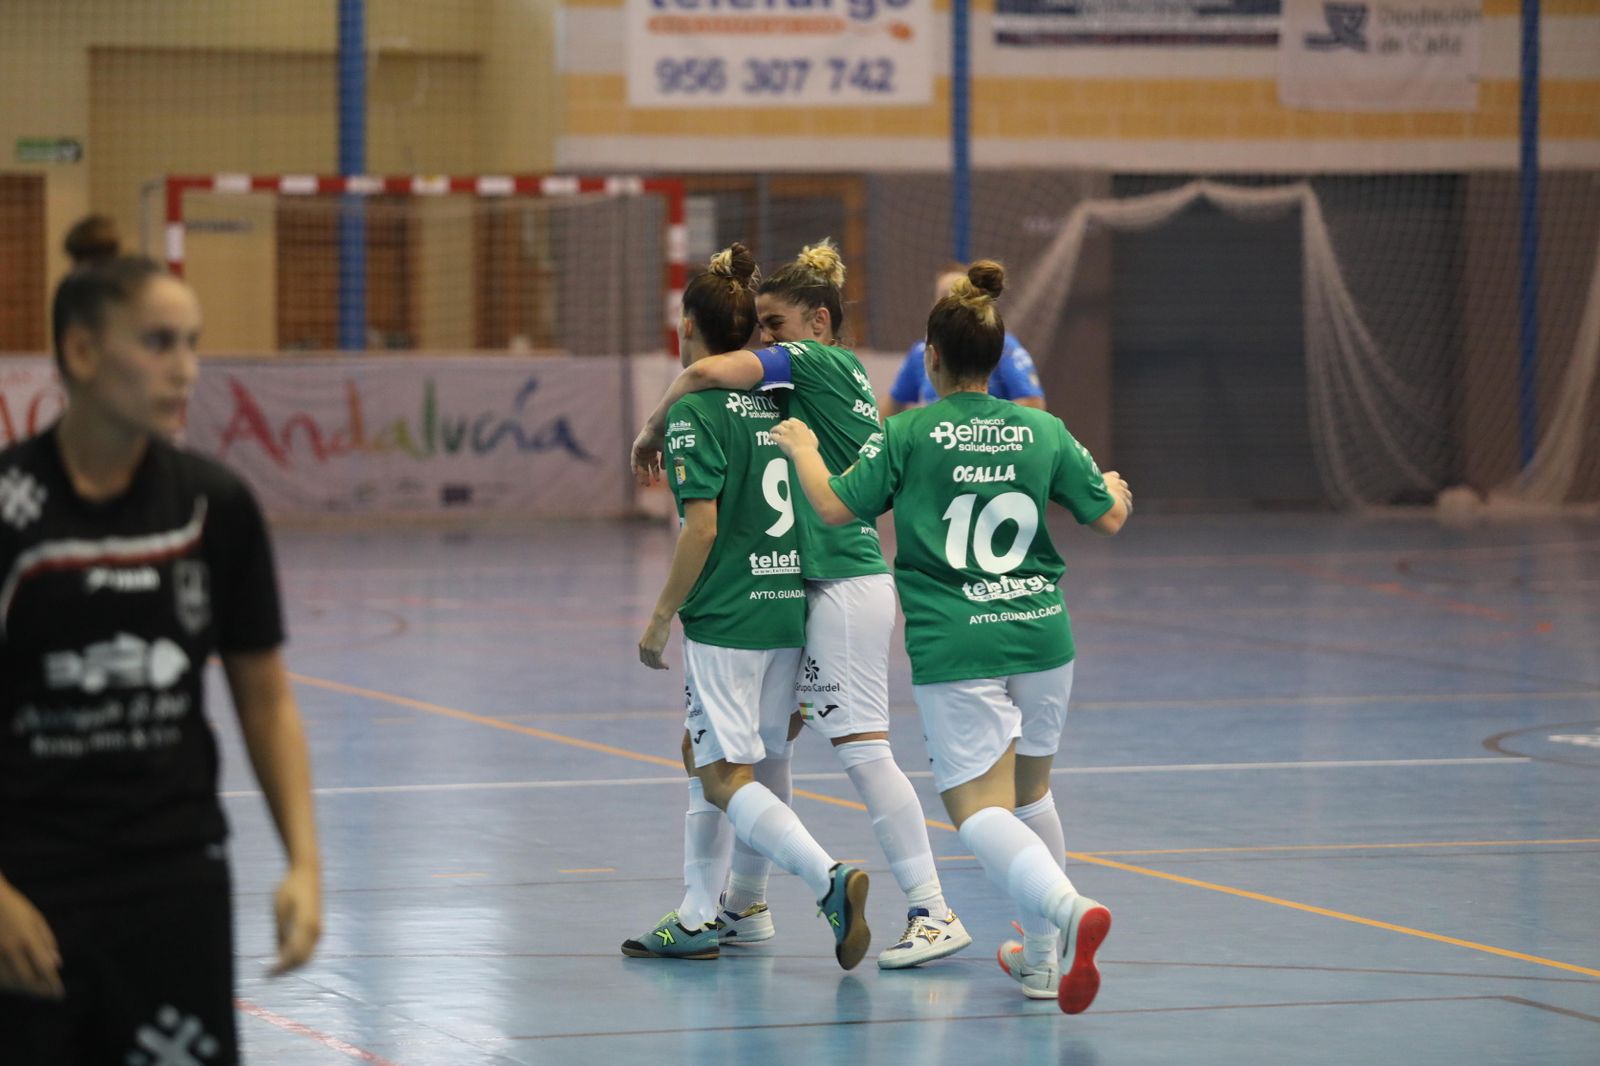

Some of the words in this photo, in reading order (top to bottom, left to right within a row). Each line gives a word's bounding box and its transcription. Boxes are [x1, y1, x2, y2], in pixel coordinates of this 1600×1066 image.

[655, 57, 727, 94] 956
[742, 57, 810, 94] 307
[823, 57, 893, 93] 742
[216, 374, 597, 470] Andalucía
[958, 442, 1023, 454] saludeporte
[953, 464, 1016, 483] OGALLA
[762, 457, 795, 538] 9
[941, 491, 1039, 574] 10
[813, 682, 840, 692] Cardel
